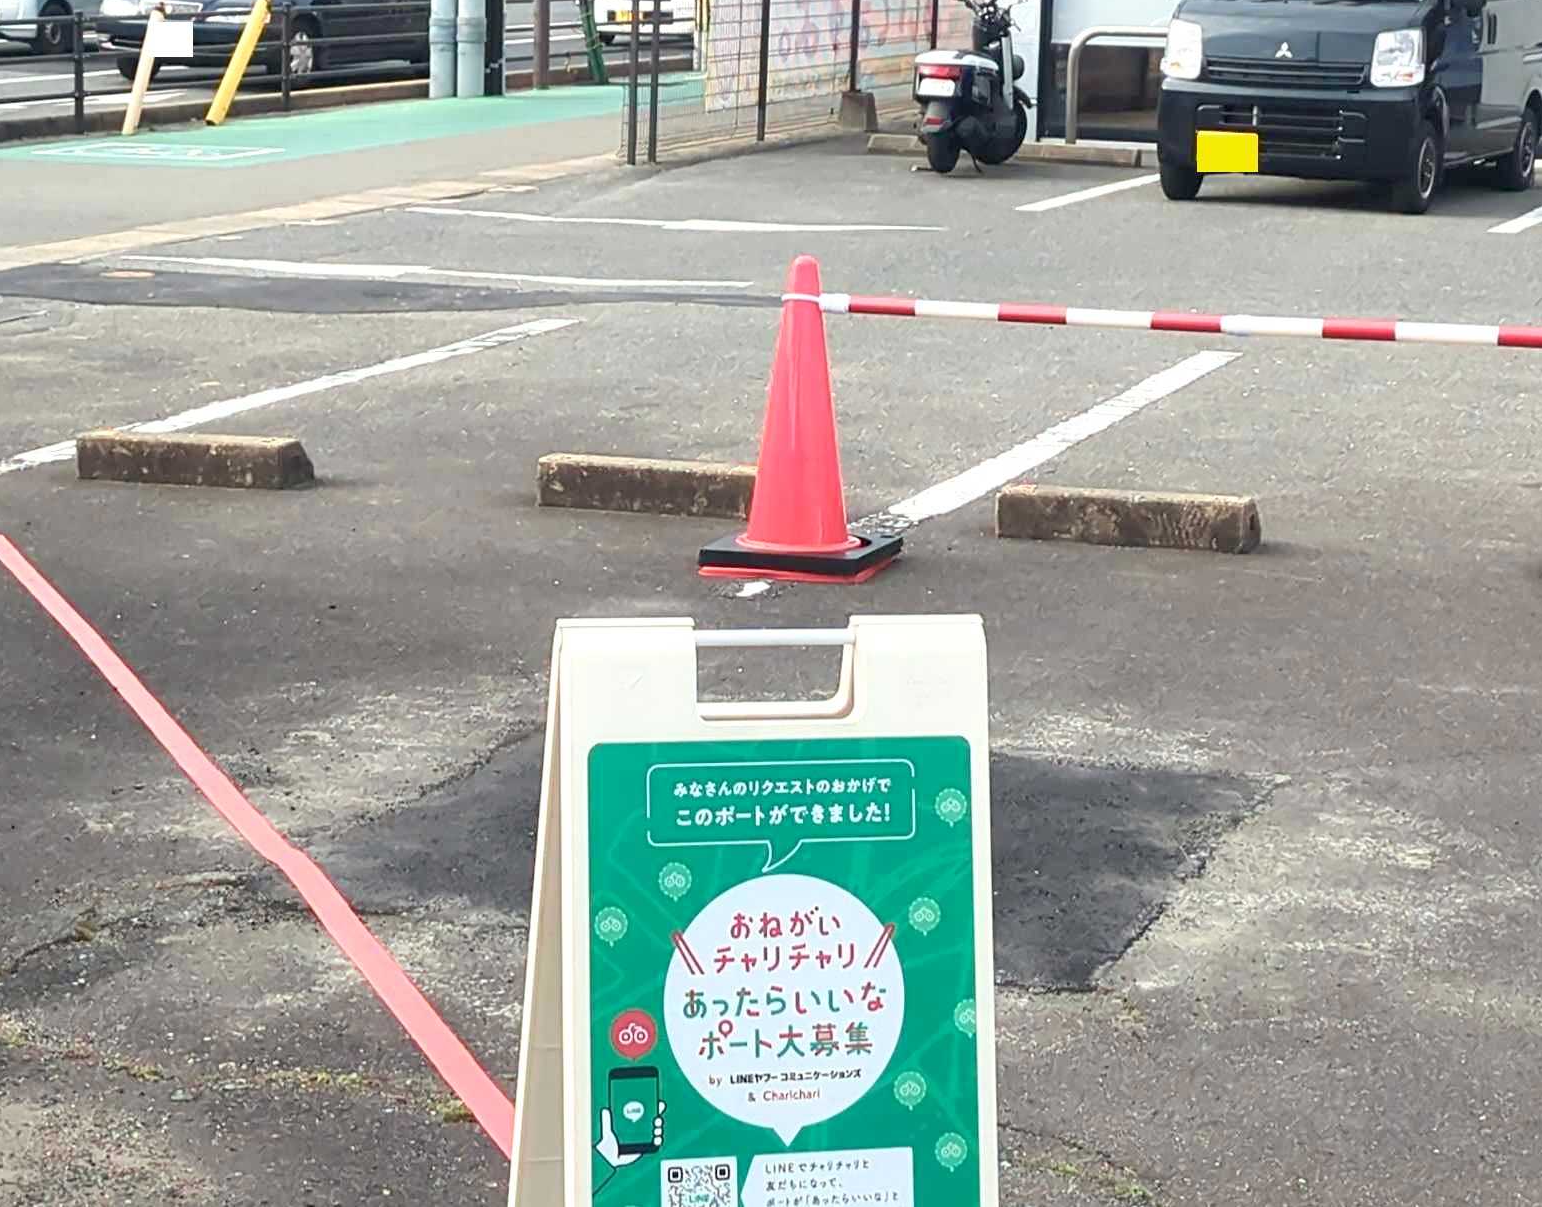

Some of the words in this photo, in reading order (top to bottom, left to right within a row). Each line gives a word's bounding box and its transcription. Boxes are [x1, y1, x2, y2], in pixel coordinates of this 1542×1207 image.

[674, 777, 892, 797] みなさんのリクエストのおかげで
[676, 802, 891, 826] このポートができました!
[730, 906, 841, 939] おねがい
[714, 943, 855, 974] チャリチャリ
[683, 981, 886, 1018] あったらいいな
[699, 1020, 873, 1060] ポート大募集
[709, 1076, 723, 1086] by
[763, 1090, 820, 1102] Charichari
